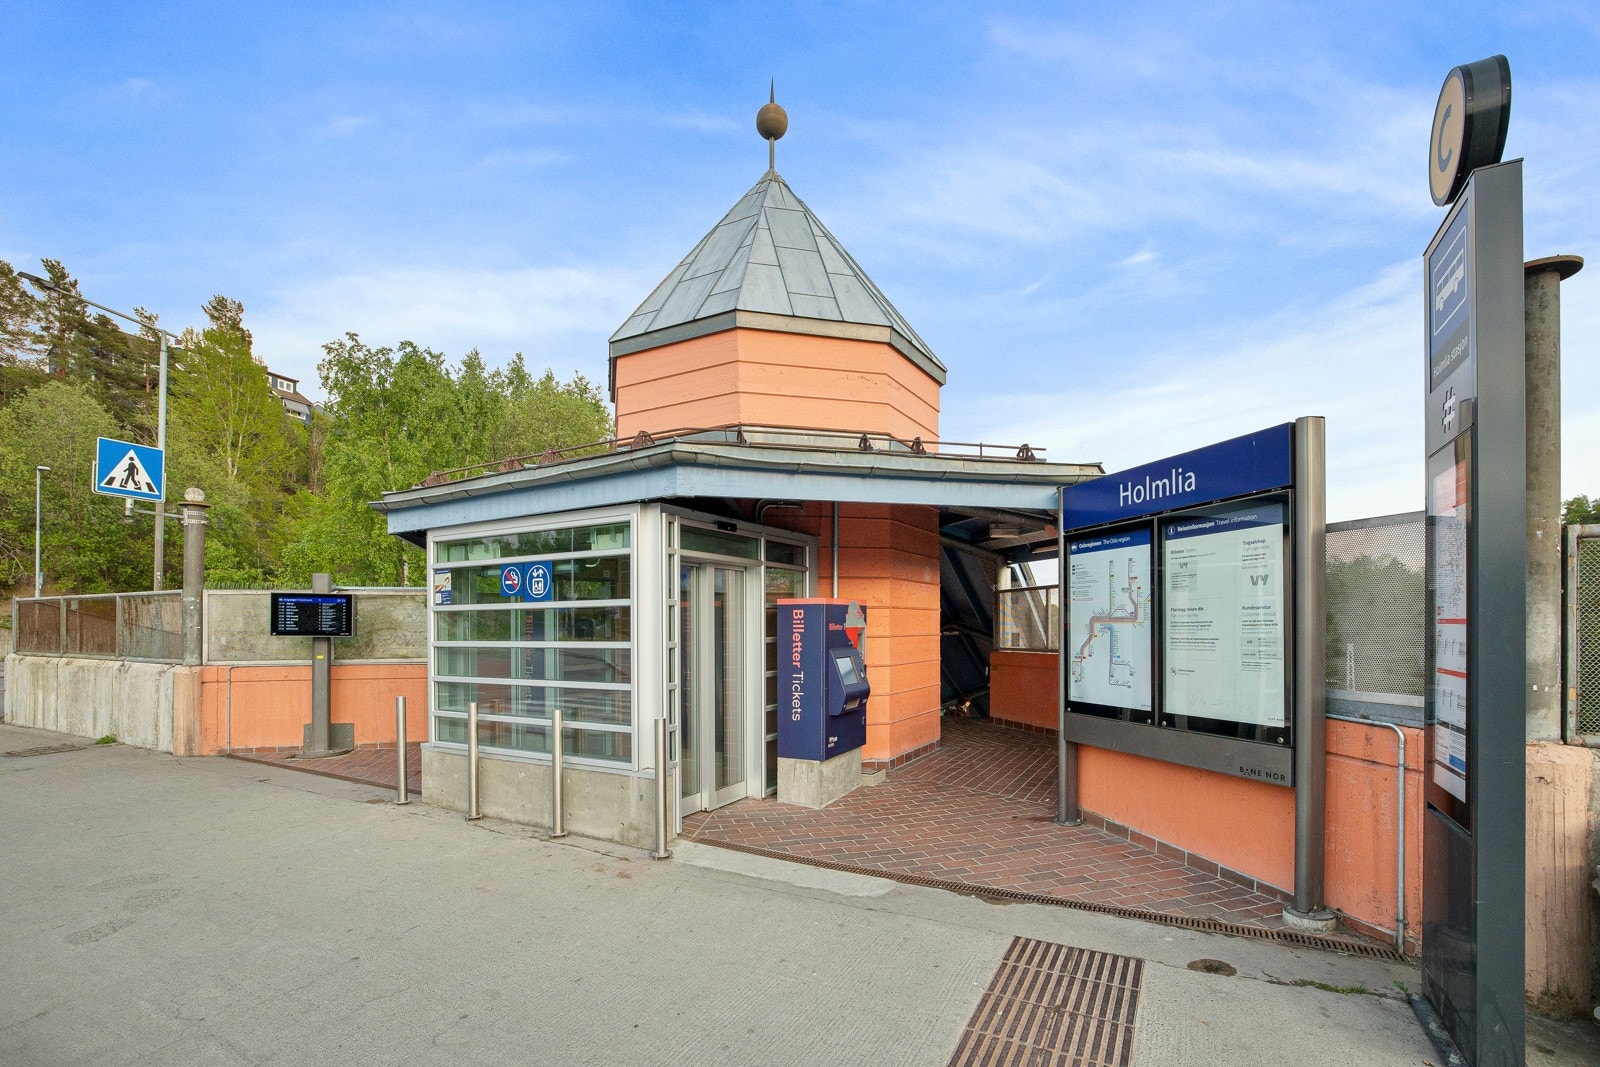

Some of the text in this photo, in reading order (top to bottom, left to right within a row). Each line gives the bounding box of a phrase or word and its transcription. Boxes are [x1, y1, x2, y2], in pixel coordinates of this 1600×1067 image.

[1434, 336, 1468, 379] Holmlia stasjon
[1120, 468, 1196, 507] Holmlia
[1178, 522, 1214, 532] Reiseinformasjon
[1230, 514, 1258, 524] information
[792, 610, 804, 721] Billetter Tickets
[1240, 766, 1286, 782] BANE NOR
